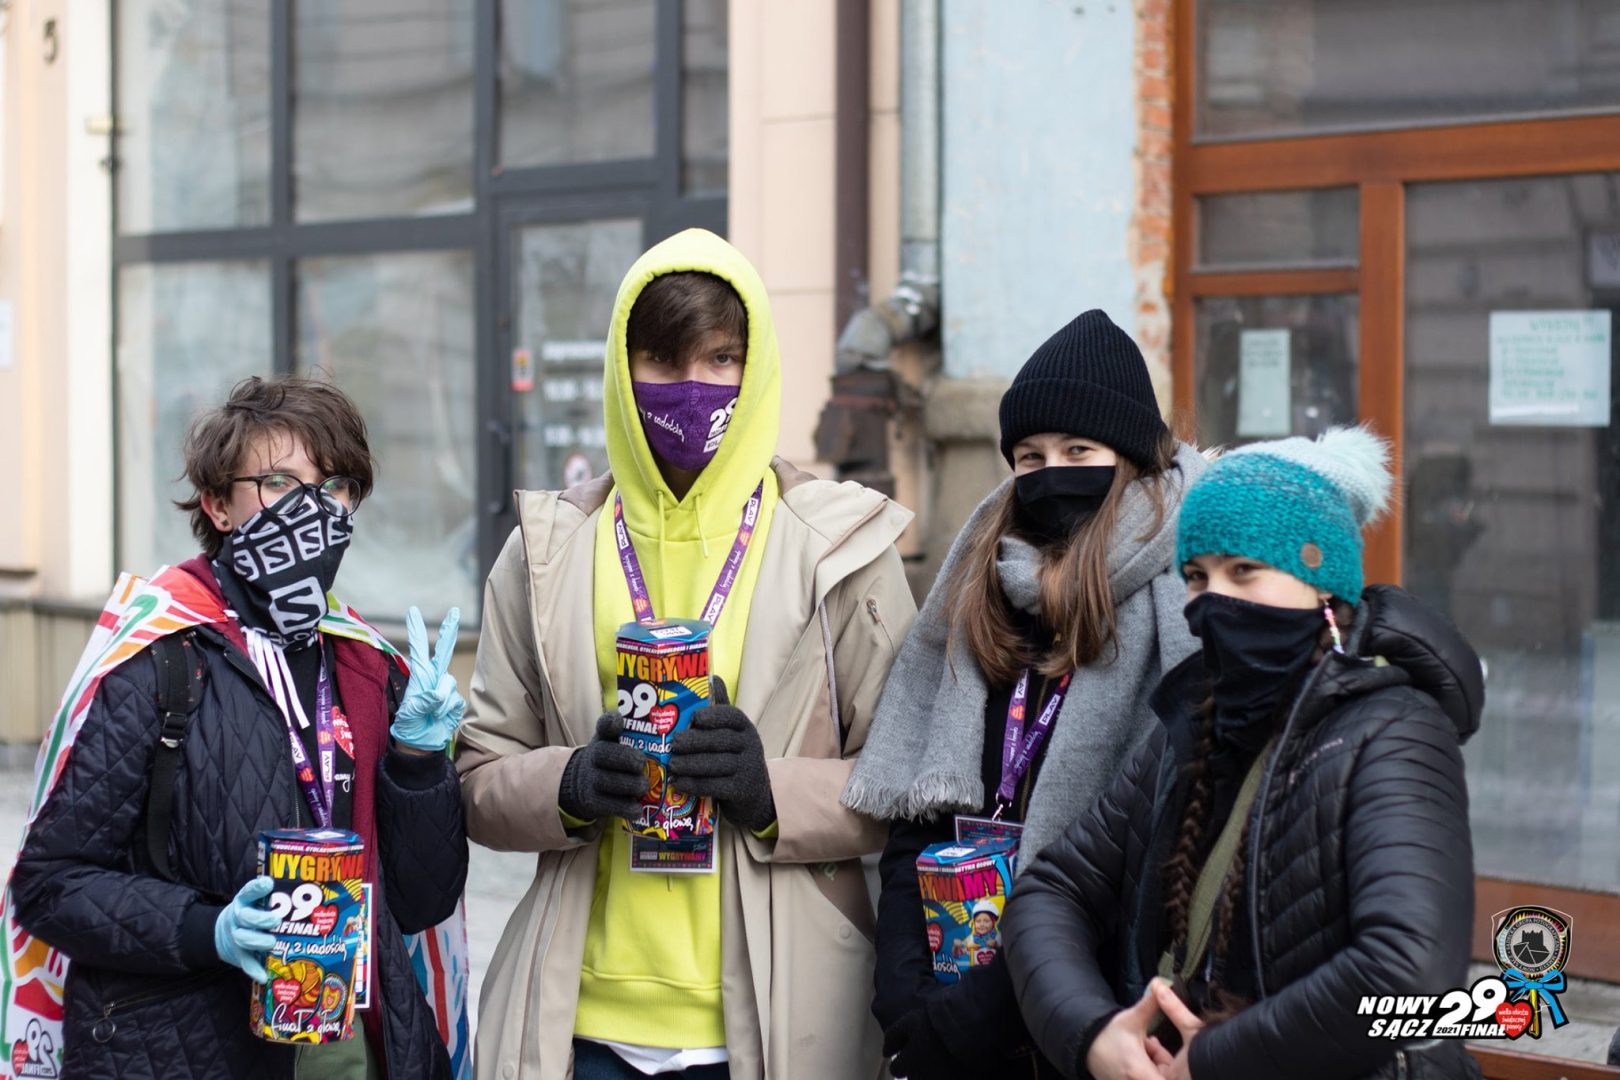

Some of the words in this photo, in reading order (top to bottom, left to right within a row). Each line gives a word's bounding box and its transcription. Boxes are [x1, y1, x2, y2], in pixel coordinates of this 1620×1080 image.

[43, 18, 59, 65] 5
[746, 499, 758, 524] PLAY
[1042, 696, 1059, 723] PLAY
[648, 733, 671, 753] rado
[324, 754, 332, 781] PLAY
[270, 883, 323, 921] 29
[281, 921, 320, 936] FINAŁ
